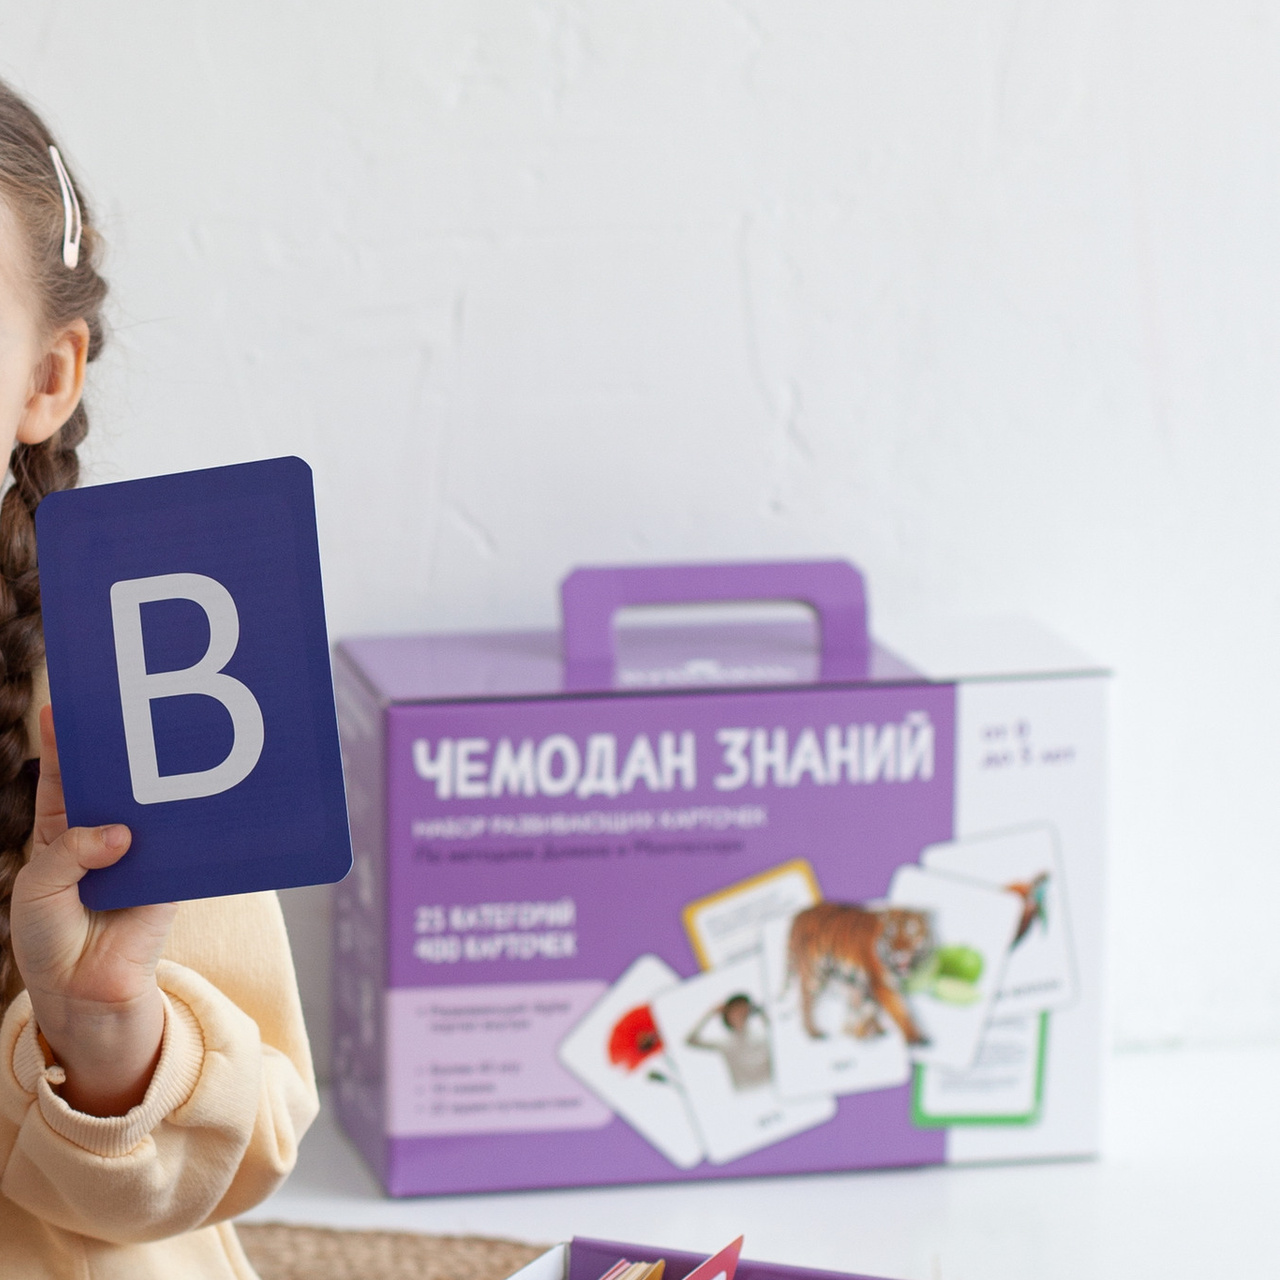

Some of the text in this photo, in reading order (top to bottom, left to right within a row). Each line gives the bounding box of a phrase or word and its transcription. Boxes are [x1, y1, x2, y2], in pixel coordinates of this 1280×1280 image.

[413, 710, 936, 800] ЧЕМОДАН ЗНАНИЙ
[660, 804, 767, 828] КАРТОЧЕК
[449, 896, 577, 929] КАТЕГОРИЙ
[464, 929, 578, 960] КАРТОЧЕК
